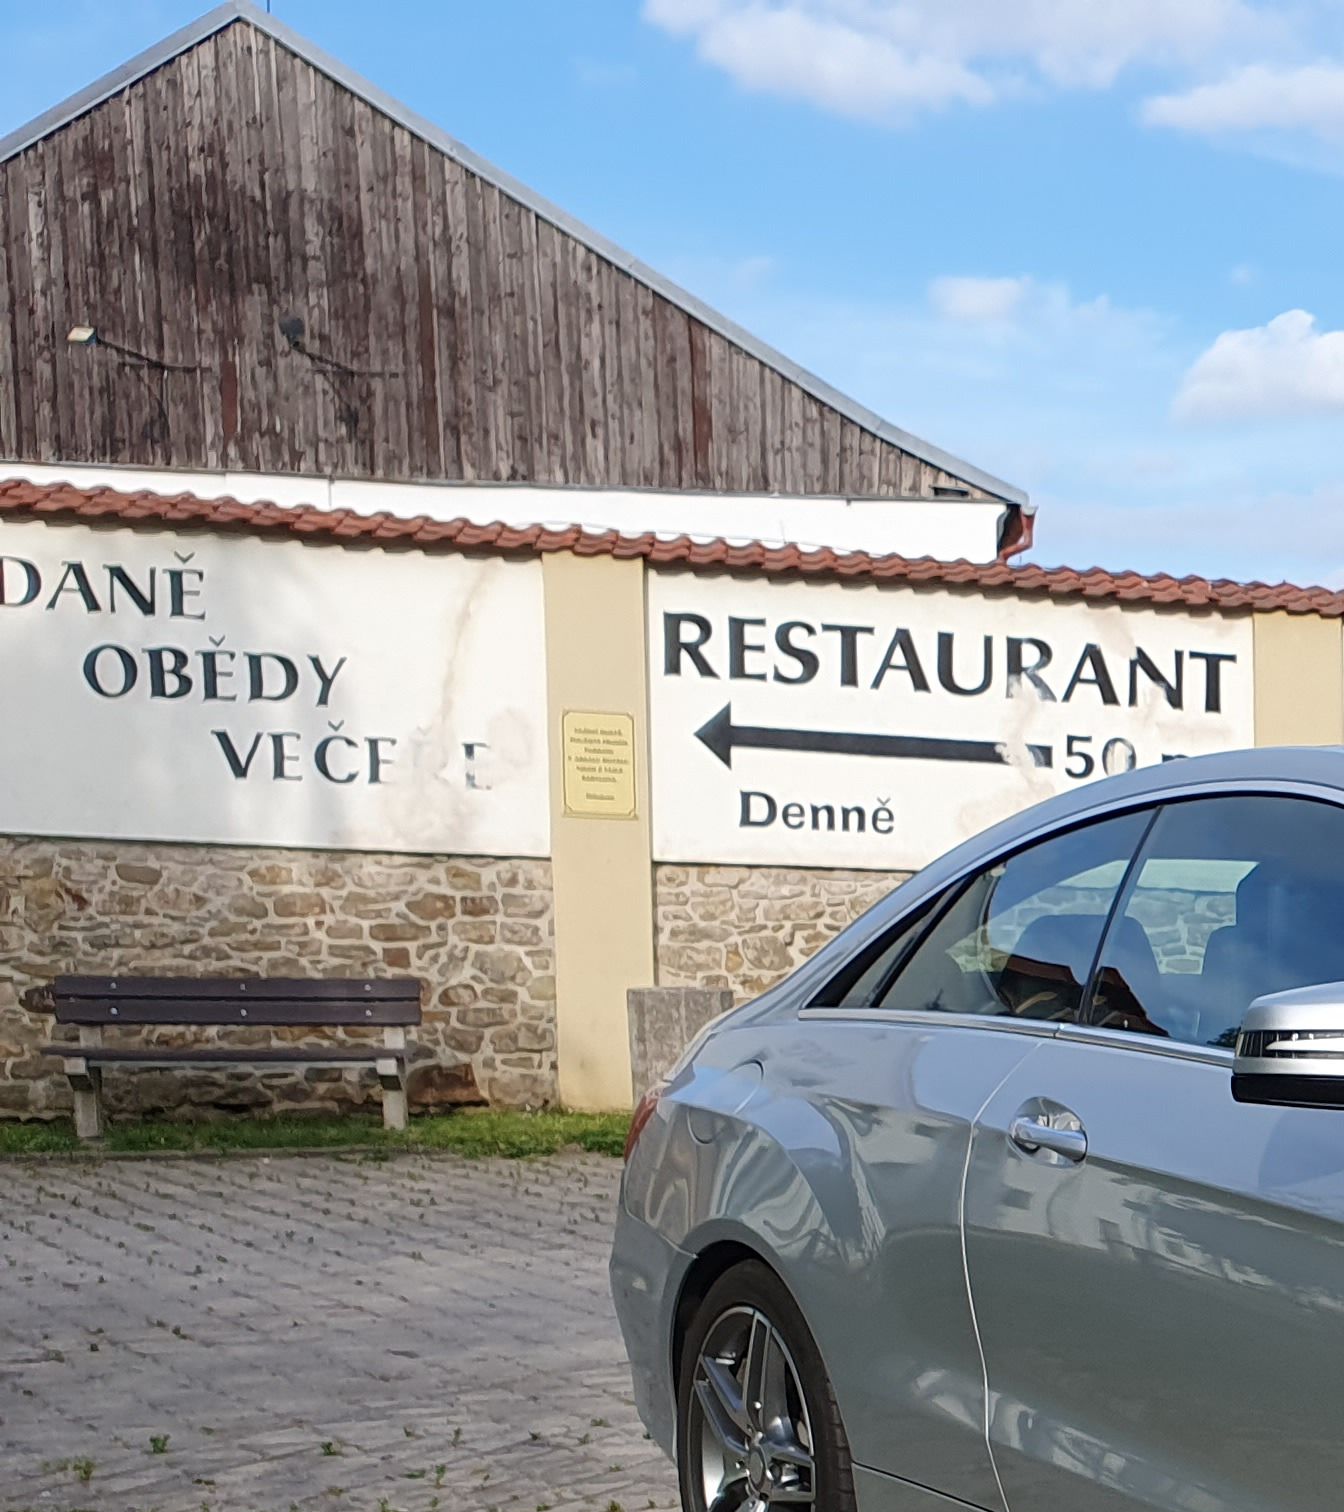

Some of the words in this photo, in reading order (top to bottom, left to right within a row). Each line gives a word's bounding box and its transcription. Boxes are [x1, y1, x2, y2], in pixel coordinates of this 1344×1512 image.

[82, 635, 347, 706] OBĚDY
[662, 610, 1238, 714] RESTAURANT
[739, 789, 895, 835] Denně
